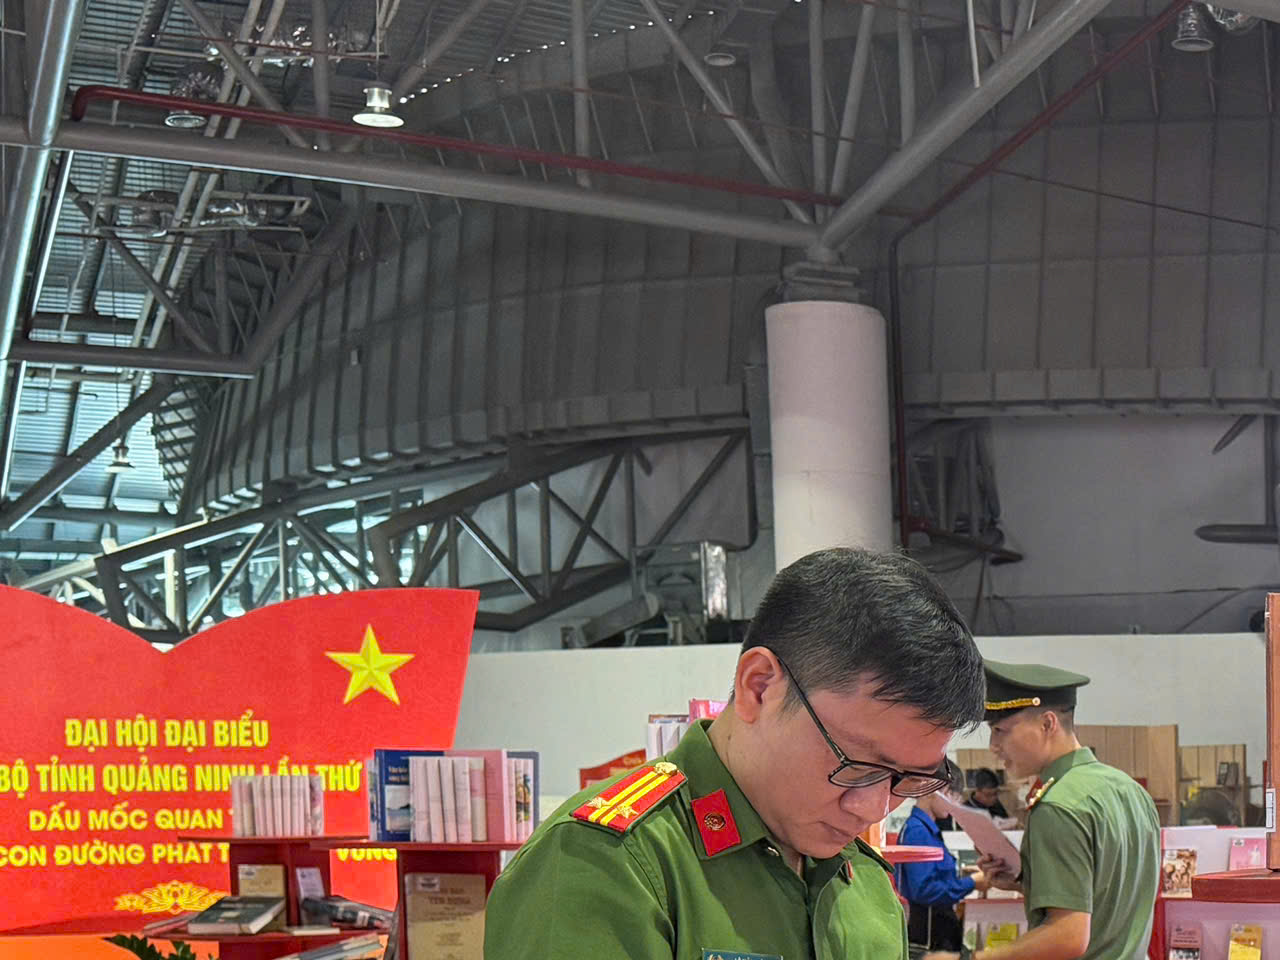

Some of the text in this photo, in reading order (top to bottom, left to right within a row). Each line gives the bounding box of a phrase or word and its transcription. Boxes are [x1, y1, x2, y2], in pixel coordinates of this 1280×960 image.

[65, 709, 269, 752] ĐẠI HỘI ĐẠI BIỂU
[36, 756, 94, 792] TỈNH
[103, 756, 188, 796] QUẢNG
[319, 758, 363, 792] THỨ
[29, 801, 223, 831] DẤU MỐC QUAN
[54, 840, 145, 866] ĐƯỜNG
